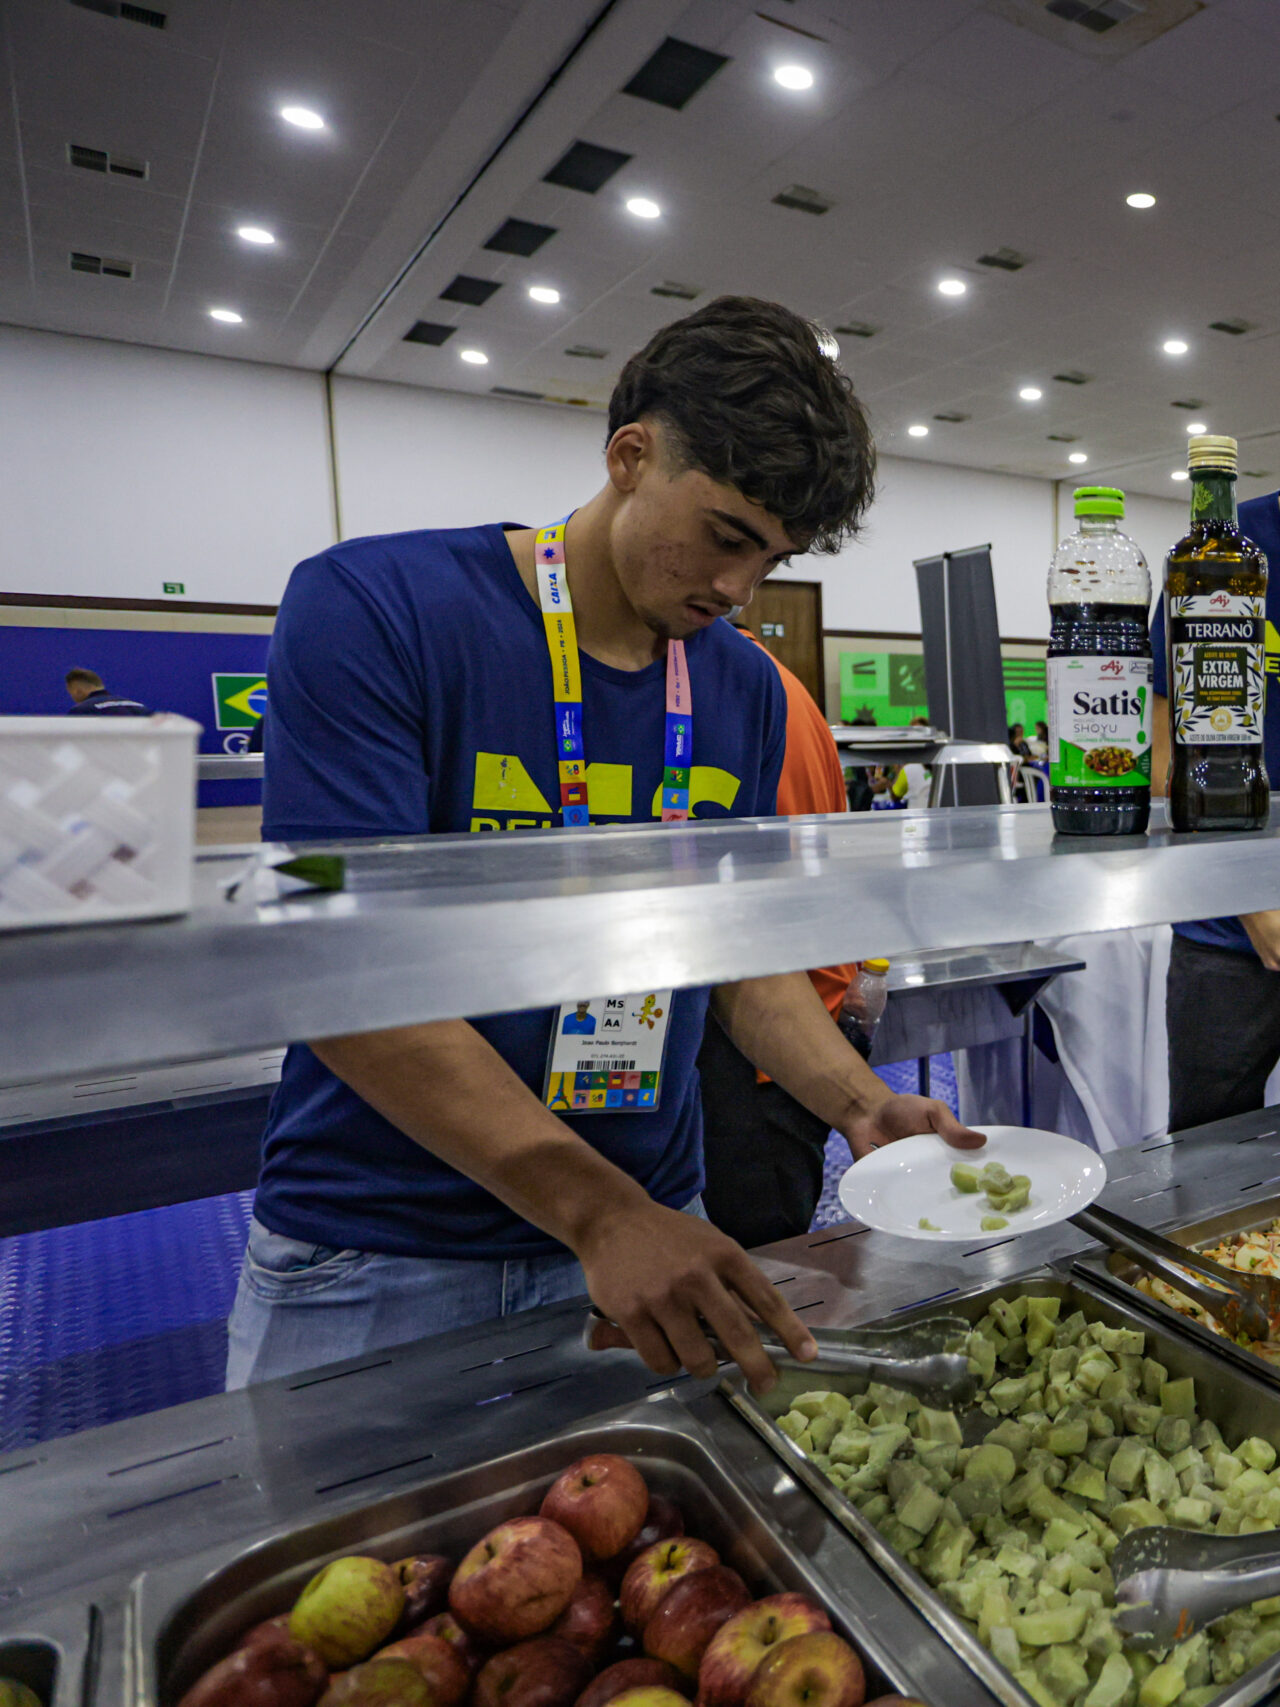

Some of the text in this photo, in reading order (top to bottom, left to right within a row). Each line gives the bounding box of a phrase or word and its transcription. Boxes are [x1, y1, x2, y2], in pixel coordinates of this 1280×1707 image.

[549, 573, 561, 604] CAIXA
[1185, 622, 1253, 638] TERRANO
[1202, 661, 1239, 674] EXTRA
[1198, 675, 1244, 688] VIRGEM
[1073, 723, 1117, 733] SHOYU
